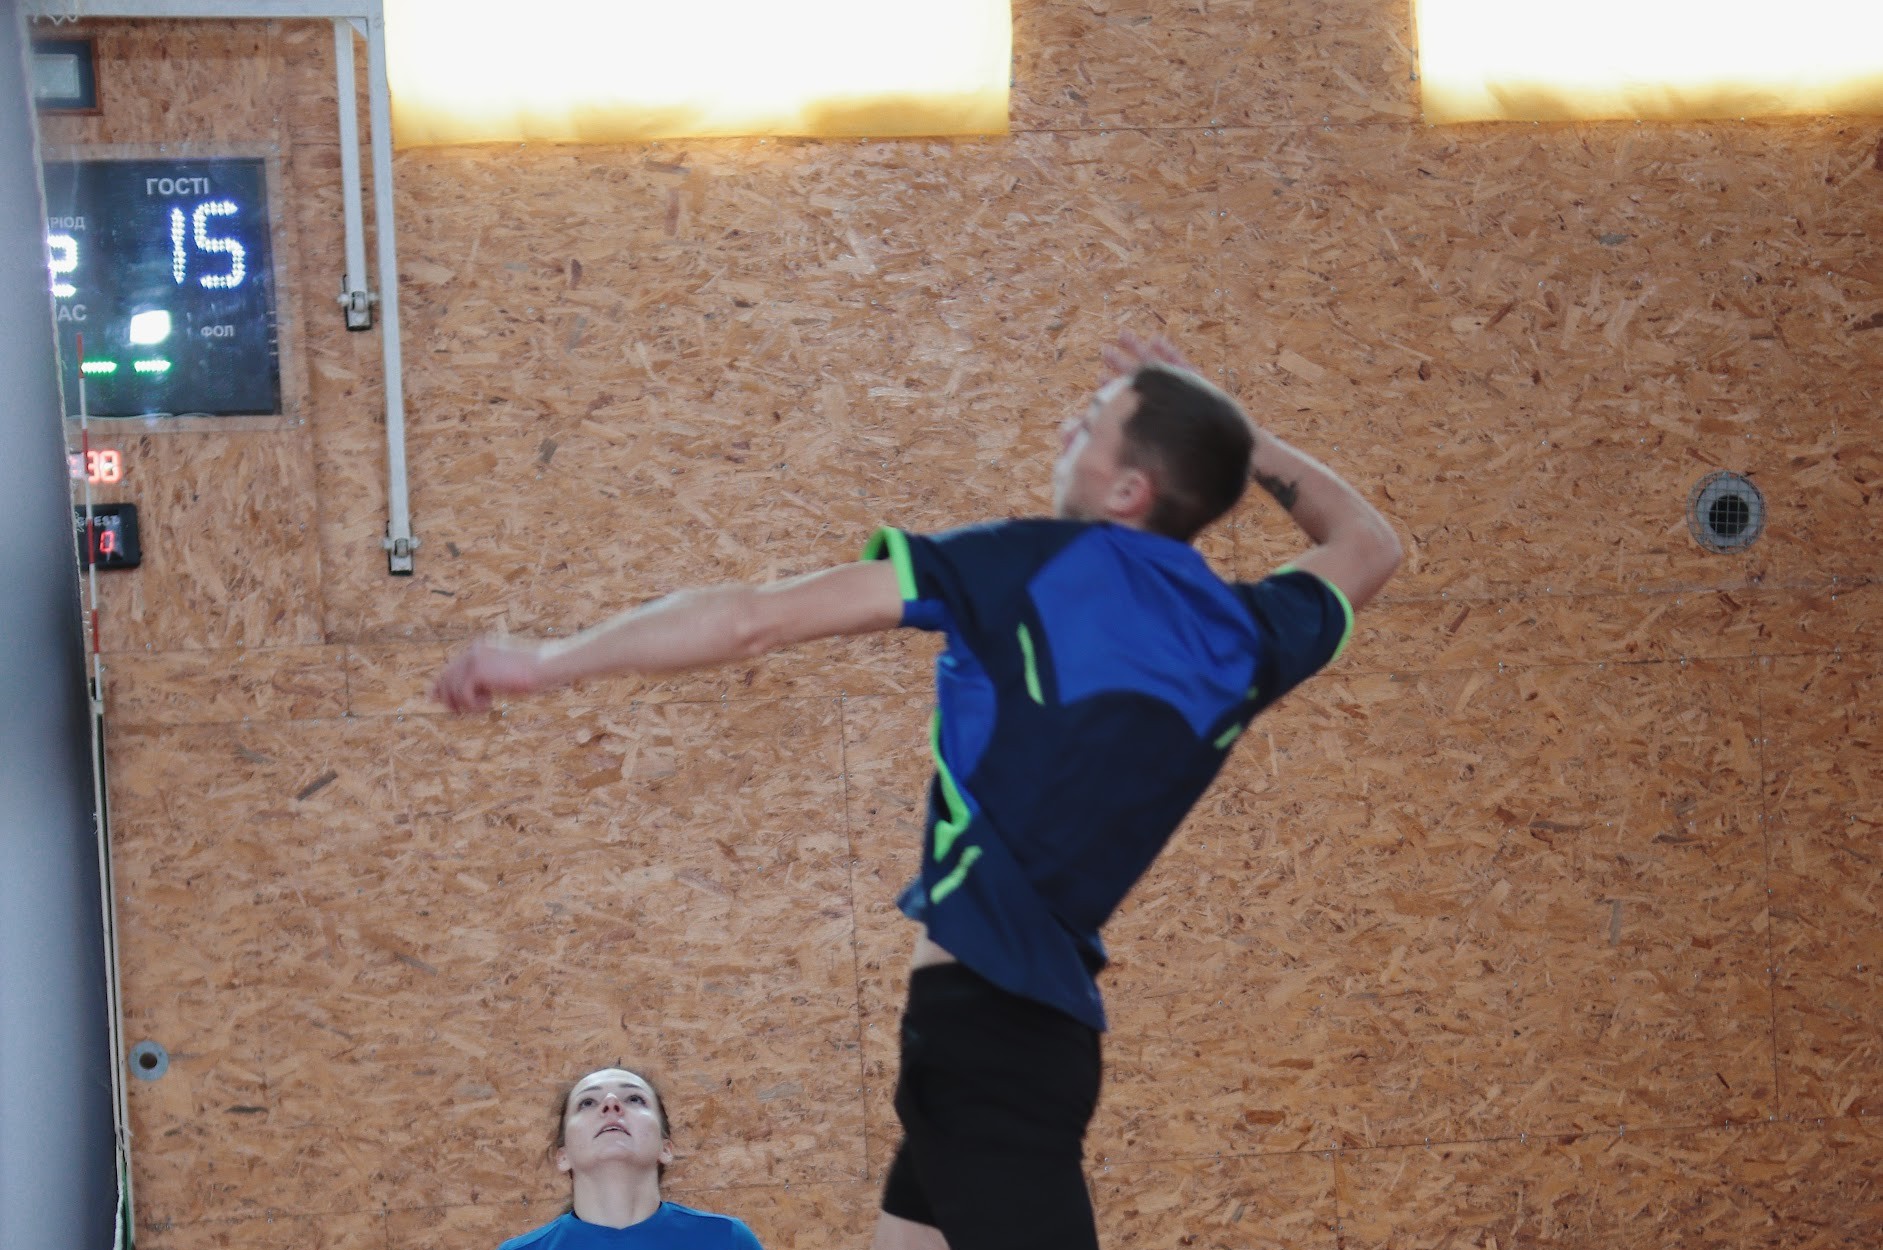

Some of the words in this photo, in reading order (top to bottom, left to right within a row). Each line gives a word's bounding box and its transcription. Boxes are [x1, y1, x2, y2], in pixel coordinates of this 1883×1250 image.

[146, 177, 210, 196] ГОСТІ
[49, 216, 86, 231] РІОД
[171, 200, 246, 289] 15
[57, 304, 87, 321] АС
[201, 325, 234, 338] ФОЛ
[100, 530, 115, 553] 0
